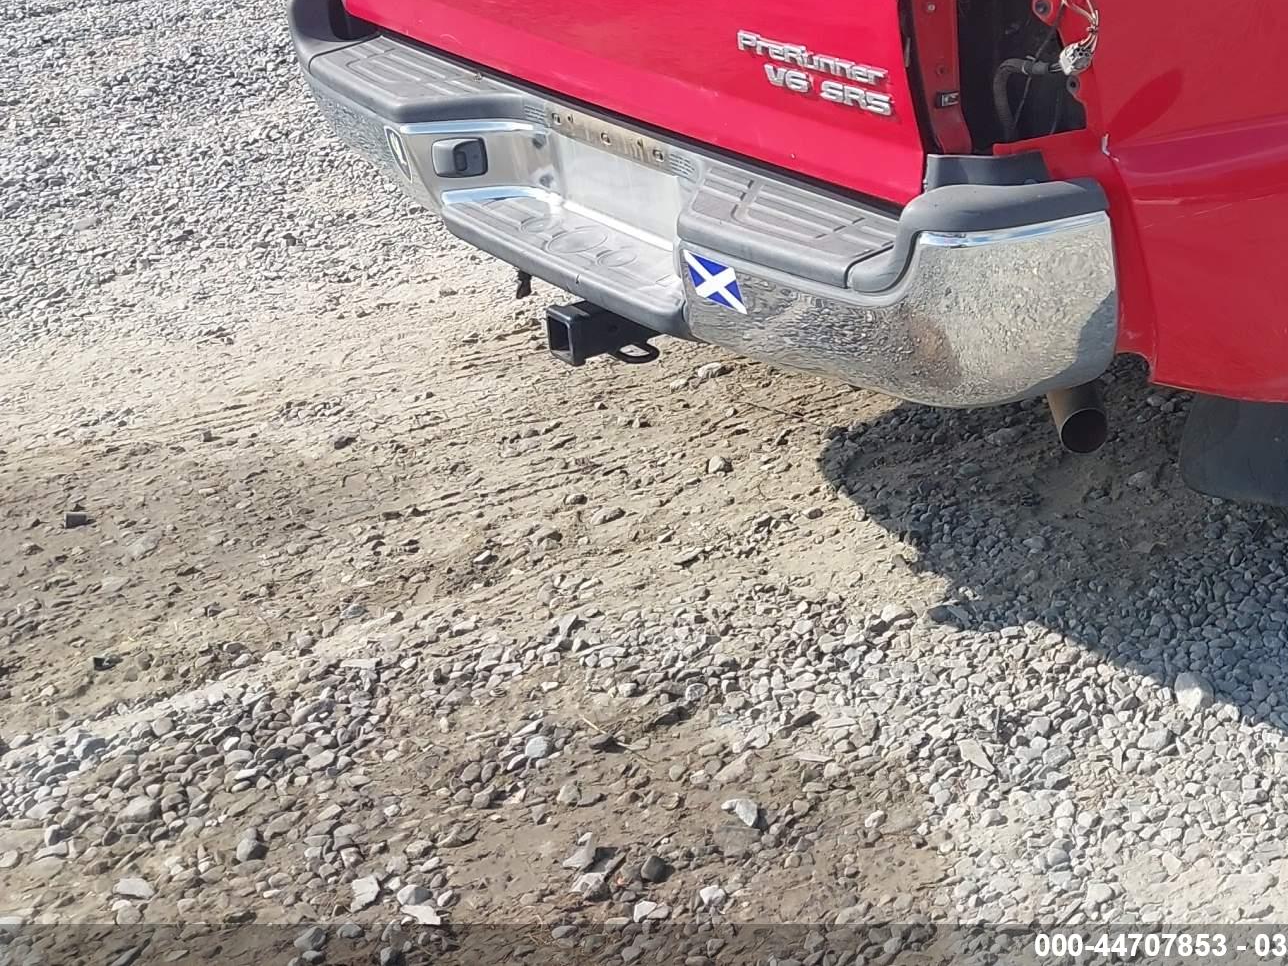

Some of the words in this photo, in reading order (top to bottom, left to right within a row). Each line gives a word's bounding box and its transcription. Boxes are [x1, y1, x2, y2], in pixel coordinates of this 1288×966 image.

[737, 29, 888, 85] PreRunner
[764, 63, 811, 93] V6
[820, 80, 893, 117] SR5
